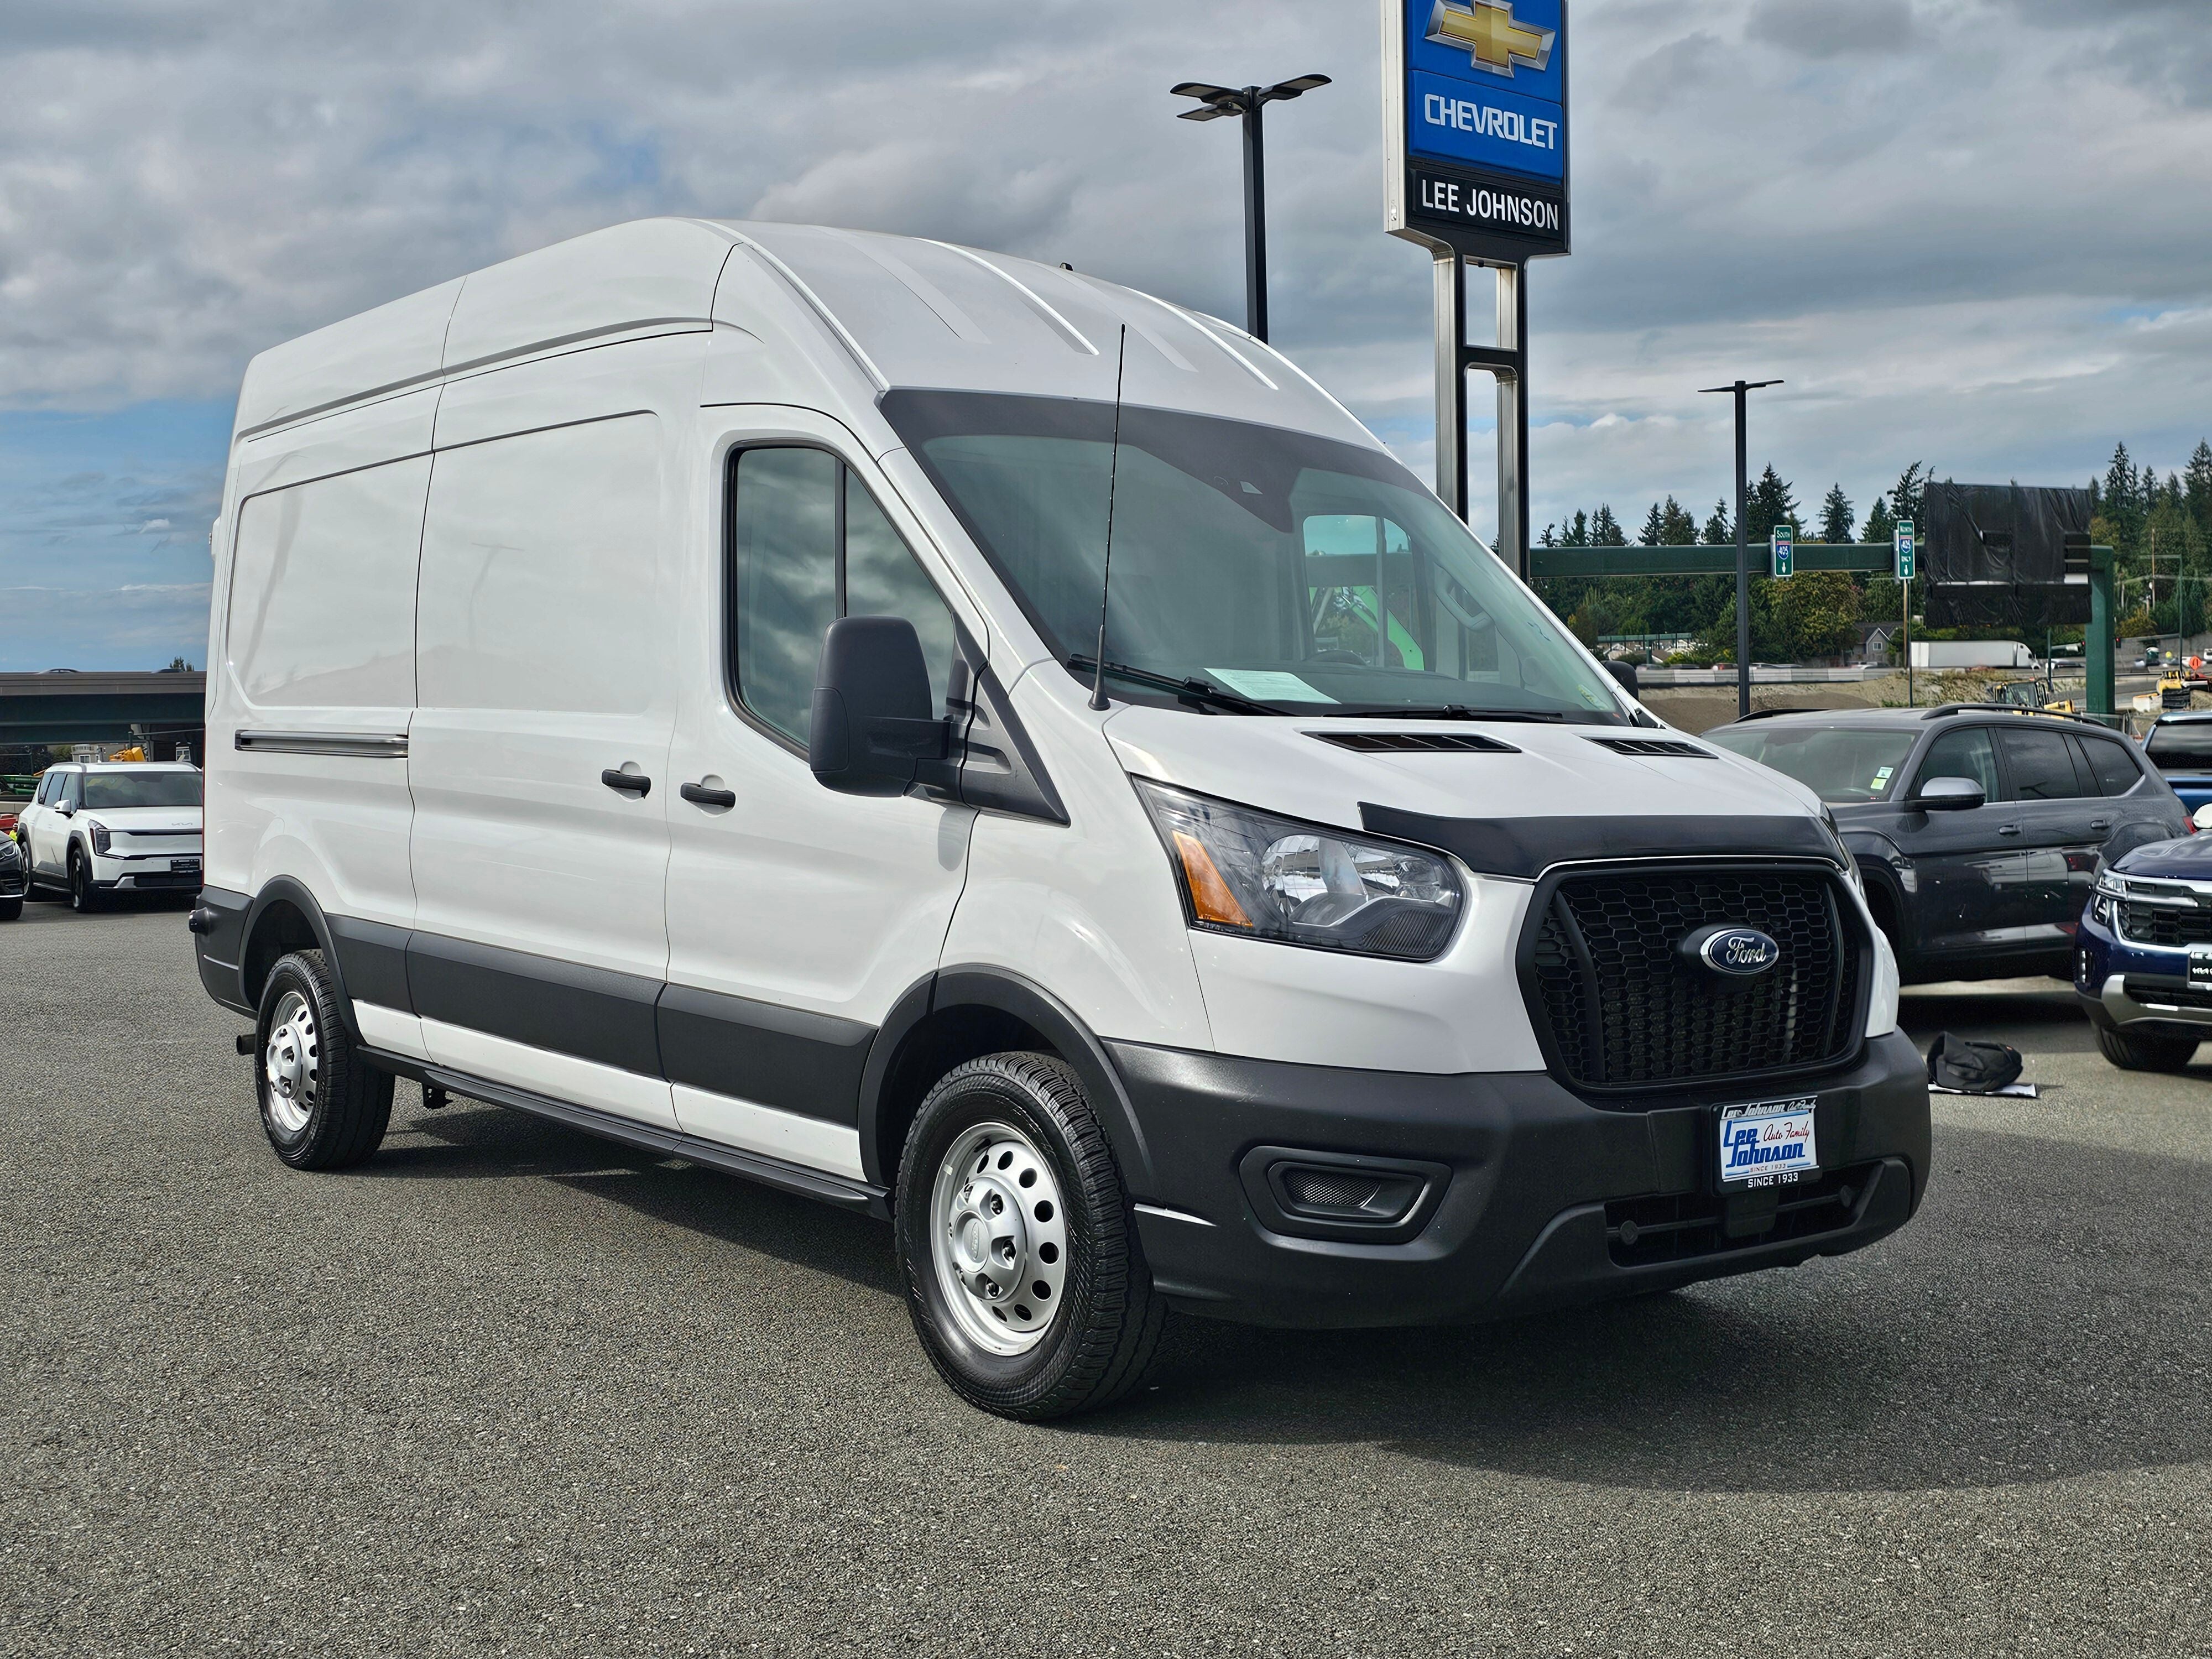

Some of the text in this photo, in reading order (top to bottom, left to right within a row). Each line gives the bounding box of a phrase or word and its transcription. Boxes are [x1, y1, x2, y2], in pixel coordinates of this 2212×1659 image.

[1425, 93, 1557, 150] CHEVROLET
[1422, 179, 1558, 230] LEE JOHNSON
[1726, 936, 1767, 964] Ford
[1742, 1103, 1785, 1117] Johnson
[1723, 1120, 1809, 1147] Lee Auto Family
[1725, 1139, 1806, 1168] Johnson
[1747, 1172, 1798, 1188] SINCE 1933
